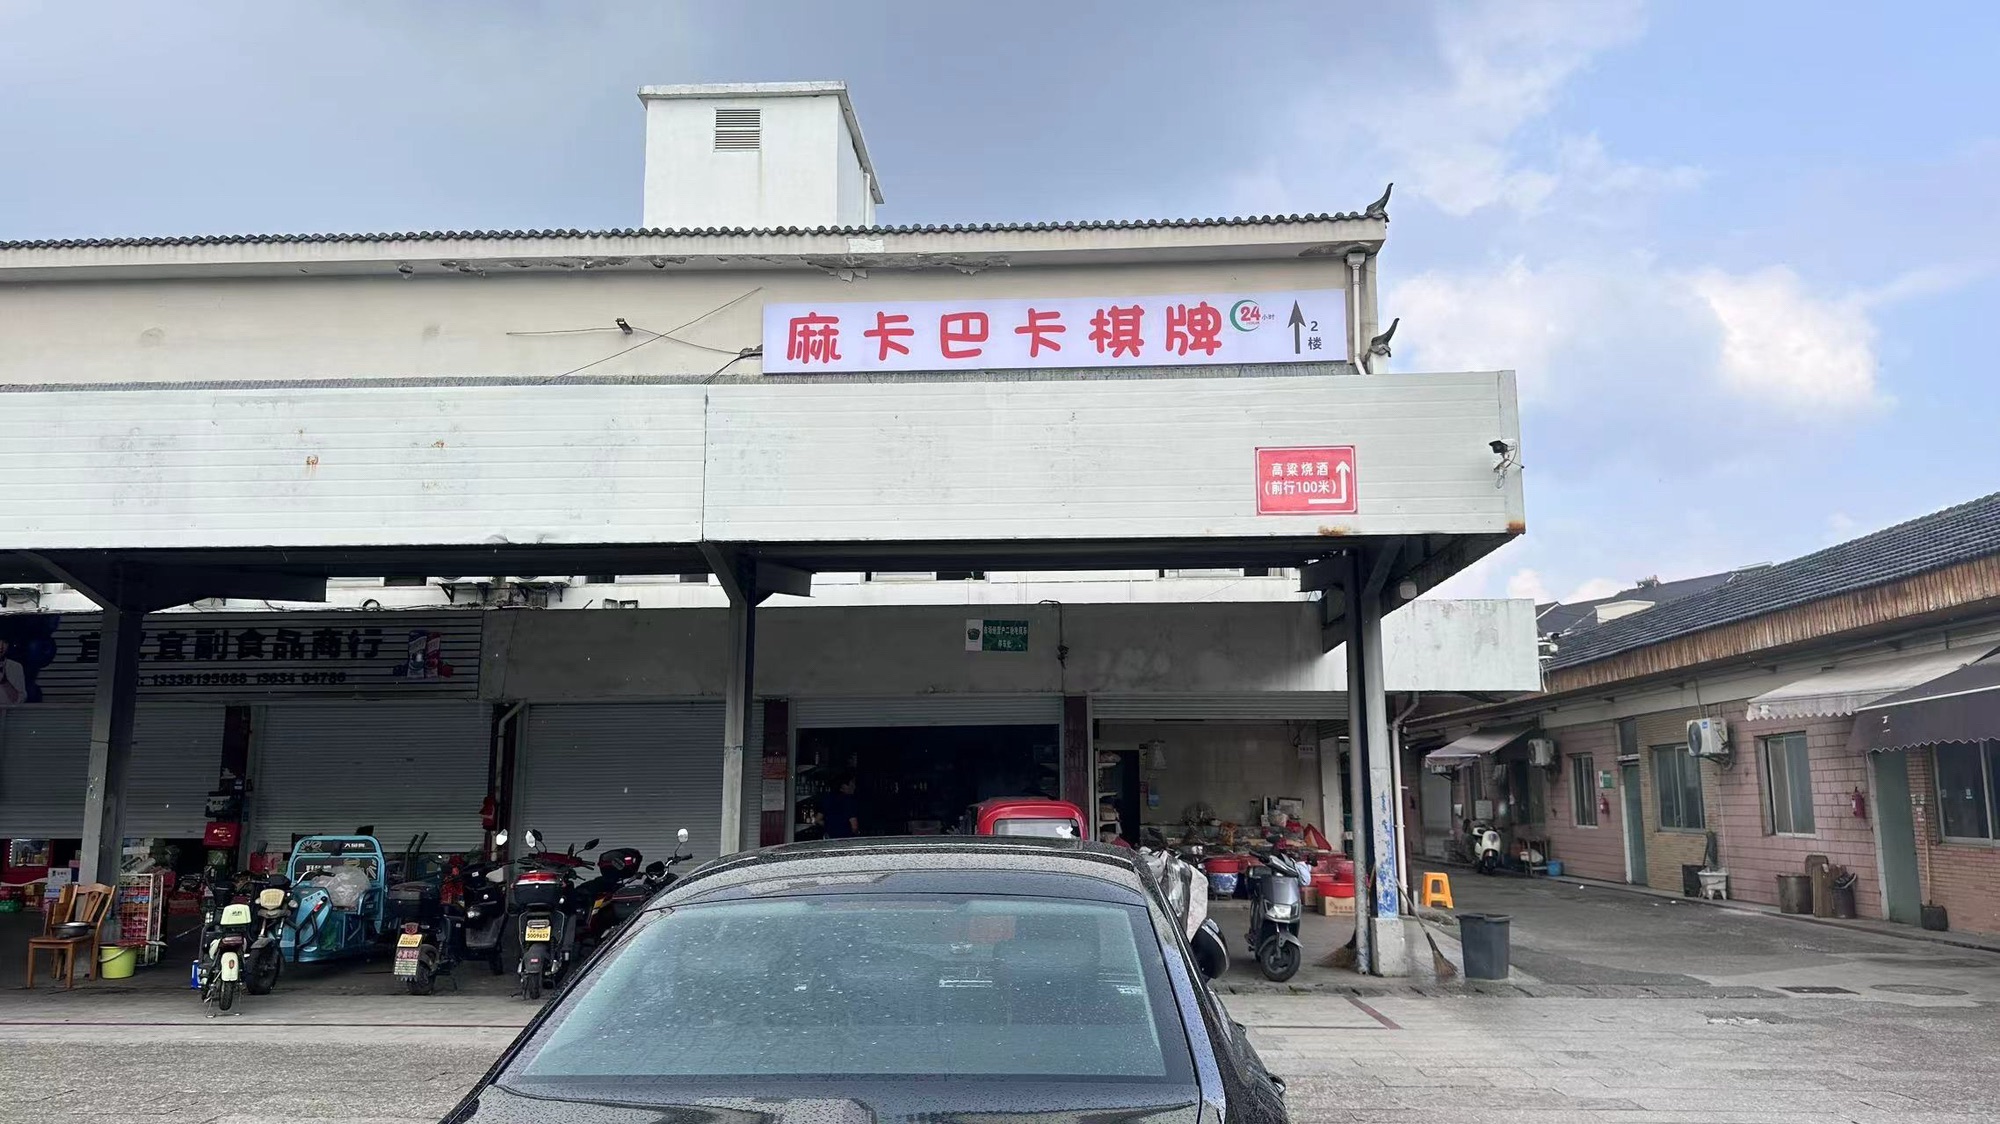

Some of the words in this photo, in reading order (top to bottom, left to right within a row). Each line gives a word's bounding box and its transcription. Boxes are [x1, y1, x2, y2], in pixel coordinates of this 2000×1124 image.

[787, 302, 1222, 363] 麻卡巴卡棋牌
[76, 628, 383, 662] 宜宜副食品商行
